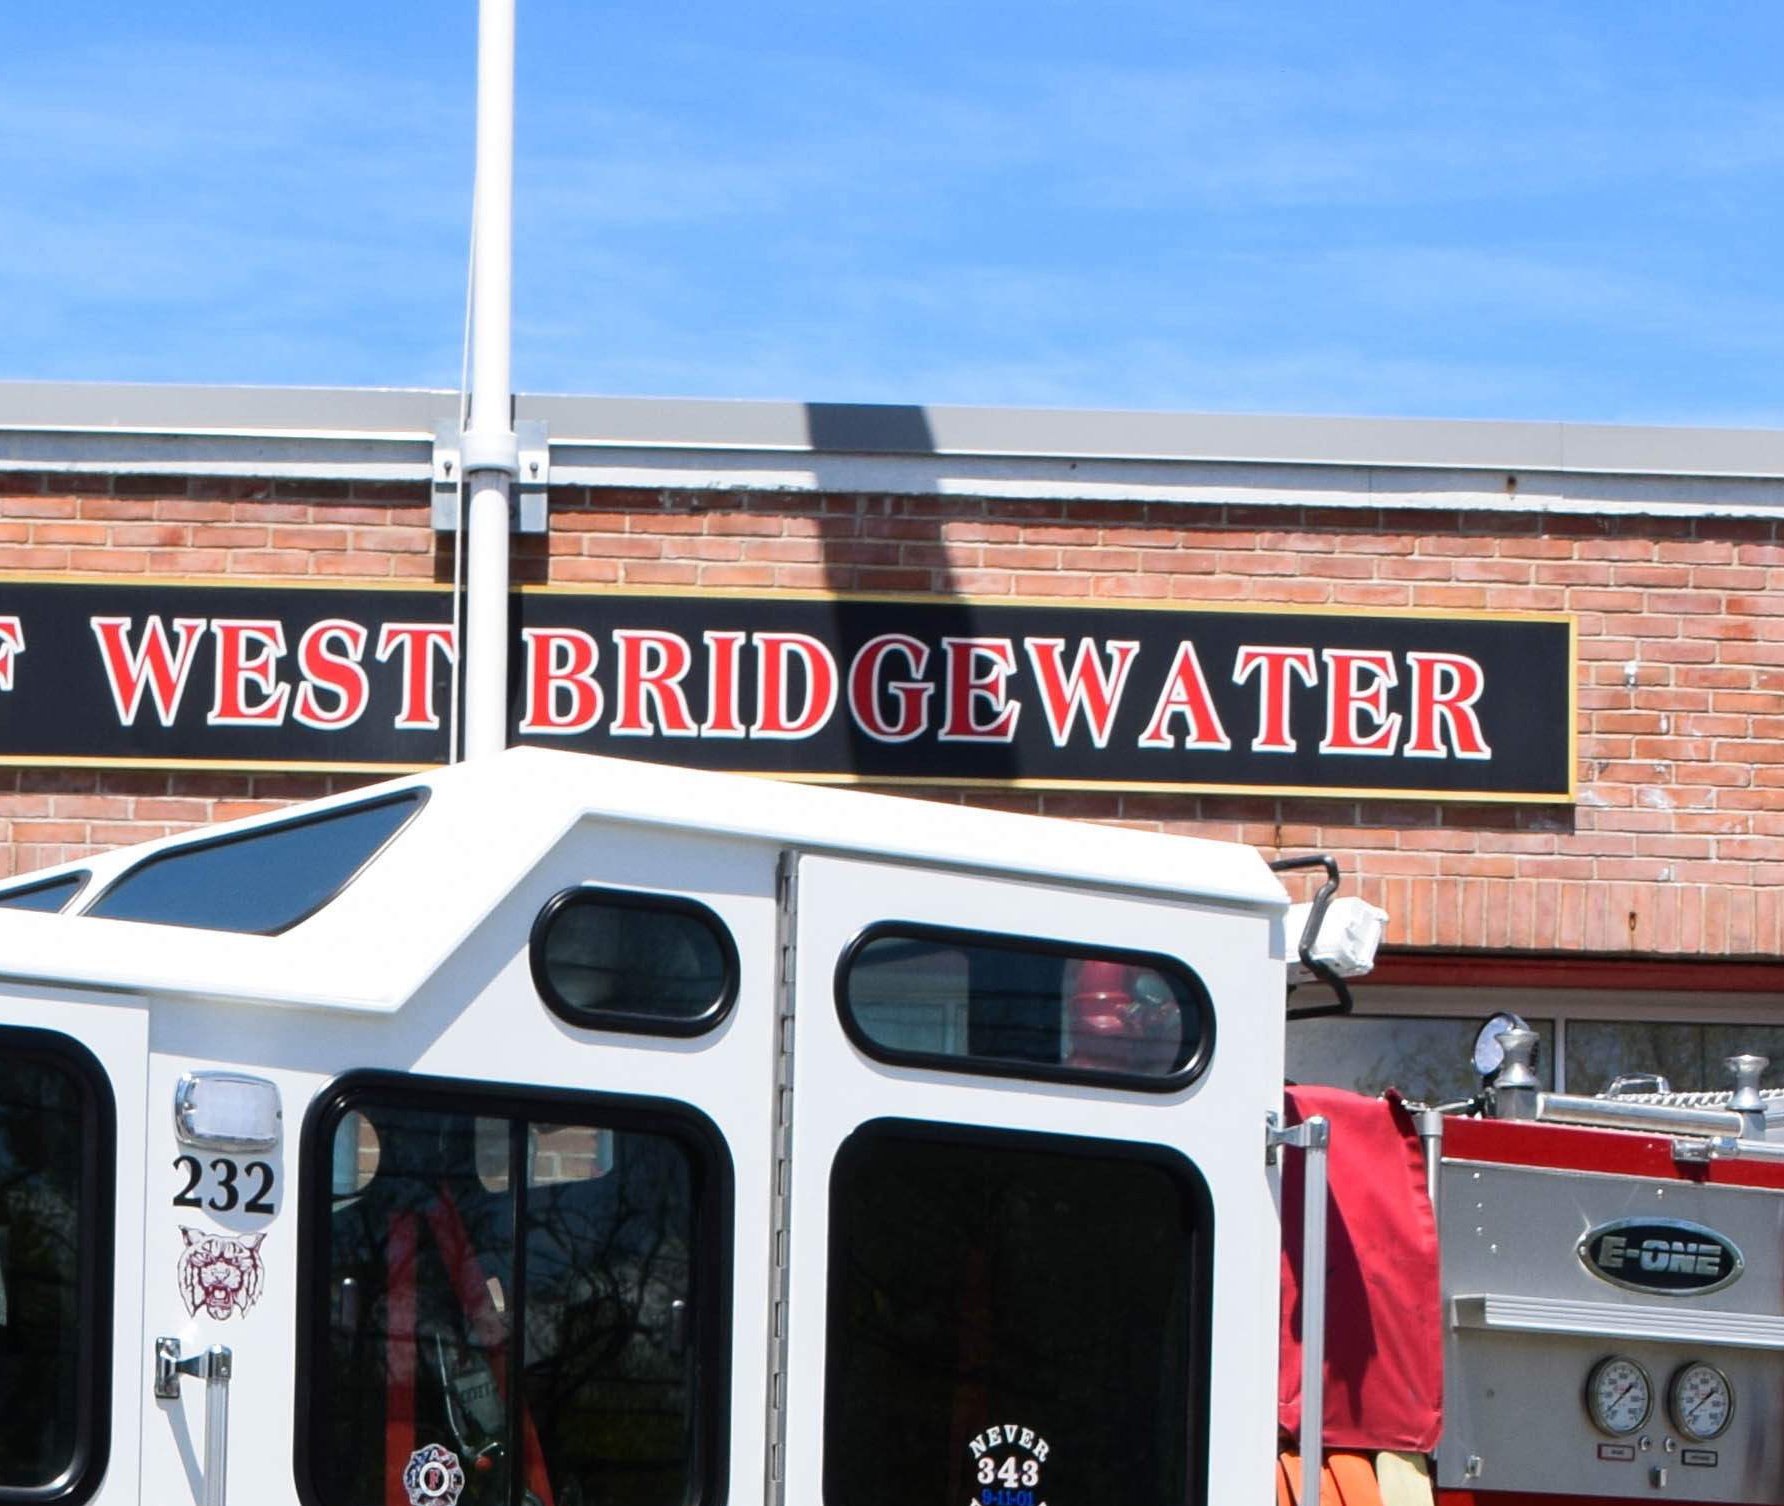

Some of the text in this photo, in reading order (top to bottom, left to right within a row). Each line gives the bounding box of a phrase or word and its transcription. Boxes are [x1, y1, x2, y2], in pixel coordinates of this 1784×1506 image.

[88, 614, 457, 731] WEST
[518, 626, 1492, 761] BRIDGEWATER
[172, 1155, 276, 1215] 232
[1598, 1235, 1722, 1277] E-ONE
[968, 1424, 1050, 1462] NEVER
[977, 1456, 1039, 1488] 343
[981, 1488, 1035, 1506] 9-11-01
